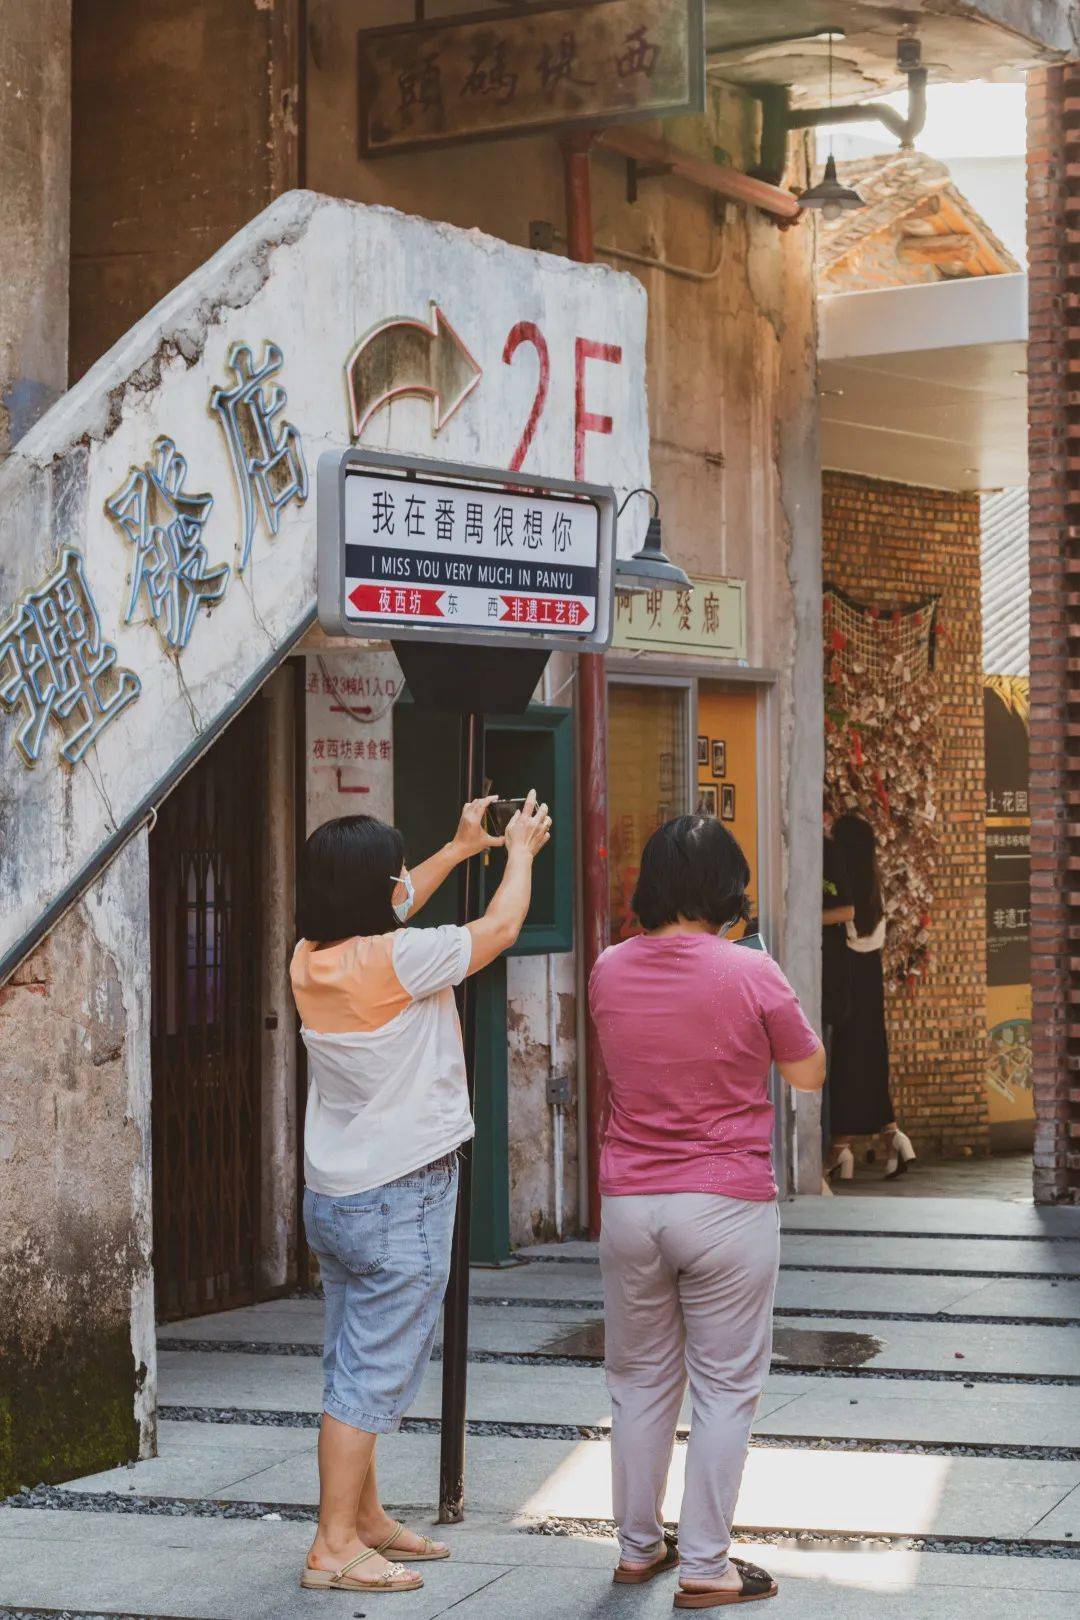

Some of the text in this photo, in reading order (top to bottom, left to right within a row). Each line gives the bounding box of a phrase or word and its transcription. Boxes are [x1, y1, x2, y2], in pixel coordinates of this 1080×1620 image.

[502, 320, 622, 496] 2F
[372, 490, 573, 553] 我在番禺很想你
[371, 556, 573, 589] I MISS YOU VERY MUCH IN PANYU
[378, 588, 581, 626] 夜西坊 东 西 非遗工艺街
[313, 738, 392, 761] 夜西坊美食街
[992, 908, 1032, 929] 非遗工
